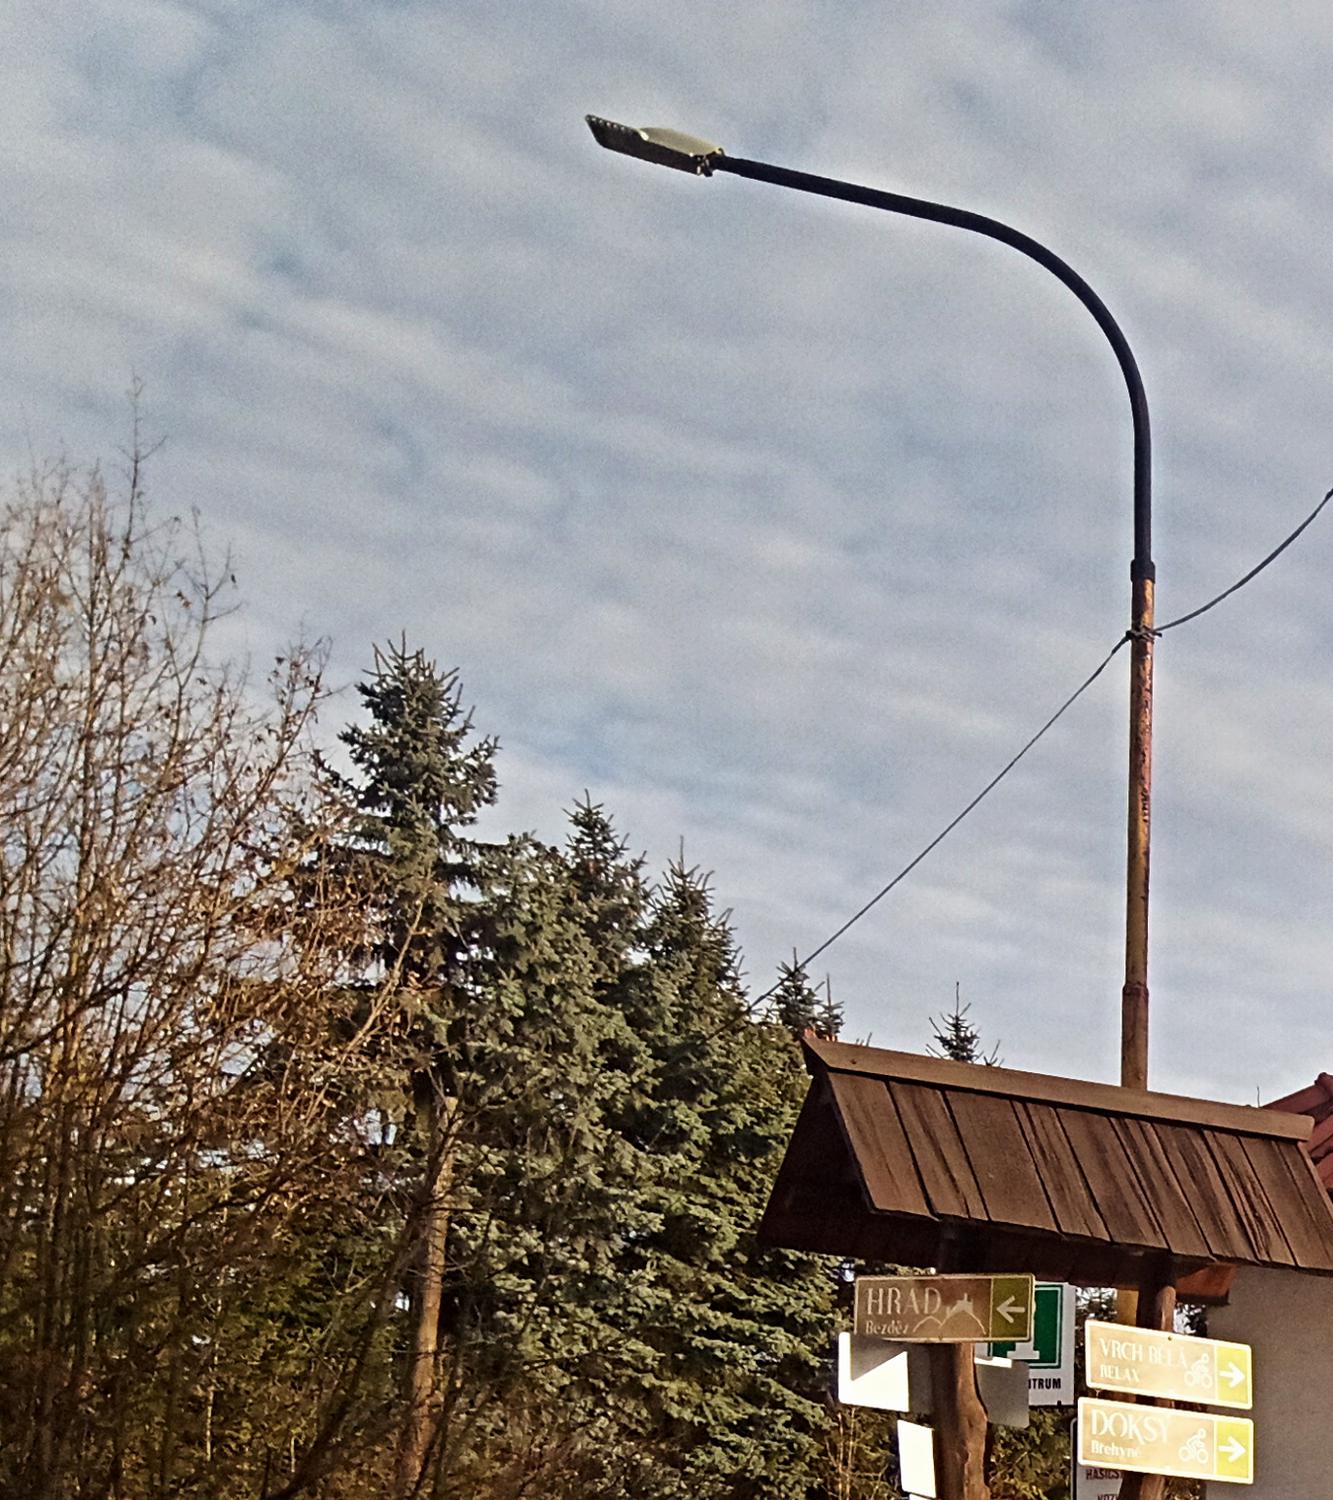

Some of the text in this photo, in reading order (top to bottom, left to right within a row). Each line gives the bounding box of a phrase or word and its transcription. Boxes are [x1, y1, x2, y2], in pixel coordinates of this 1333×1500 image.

[867, 1287, 941, 1314] HRAD
[1099, 1338, 1144, 1362] VRCH
[1028, 1378, 1061, 1389] TRUM
[1100, 1364, 1140, 1383] RELAX
[1091, 1409, 1169, 1445] DOKSY
